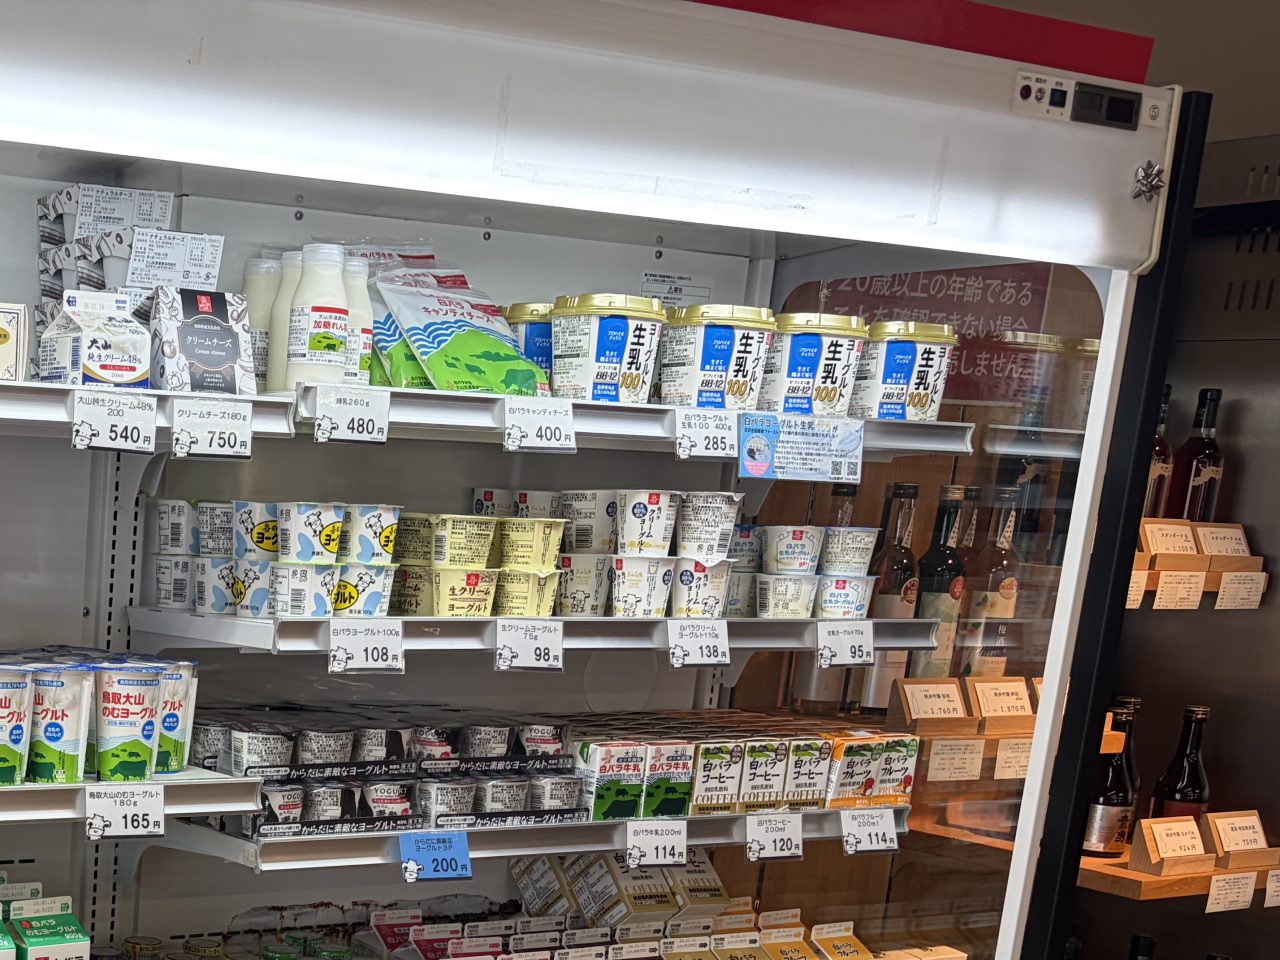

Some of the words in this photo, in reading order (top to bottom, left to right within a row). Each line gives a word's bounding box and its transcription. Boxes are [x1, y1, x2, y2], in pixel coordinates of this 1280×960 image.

[186, 335, 232, 349] クリームチーズ
[684, 414, 729, 422] 白バラヨーグルト
[449, 585, 491, 598] 生クリーム
[501, 625, 559, 634] 生クリームヨーグルト
[599, 765, 640, 774] 白バラ牛乳
[649, 762, 690, 772] 白バラ牛乳
[290, 765, 388, 780] からだに素敵なヨーグルト
[89, 790, 160, 800] 鳥取大山のむヨーグルト
[757, 819, 791, 827] 白バラコーヒー
